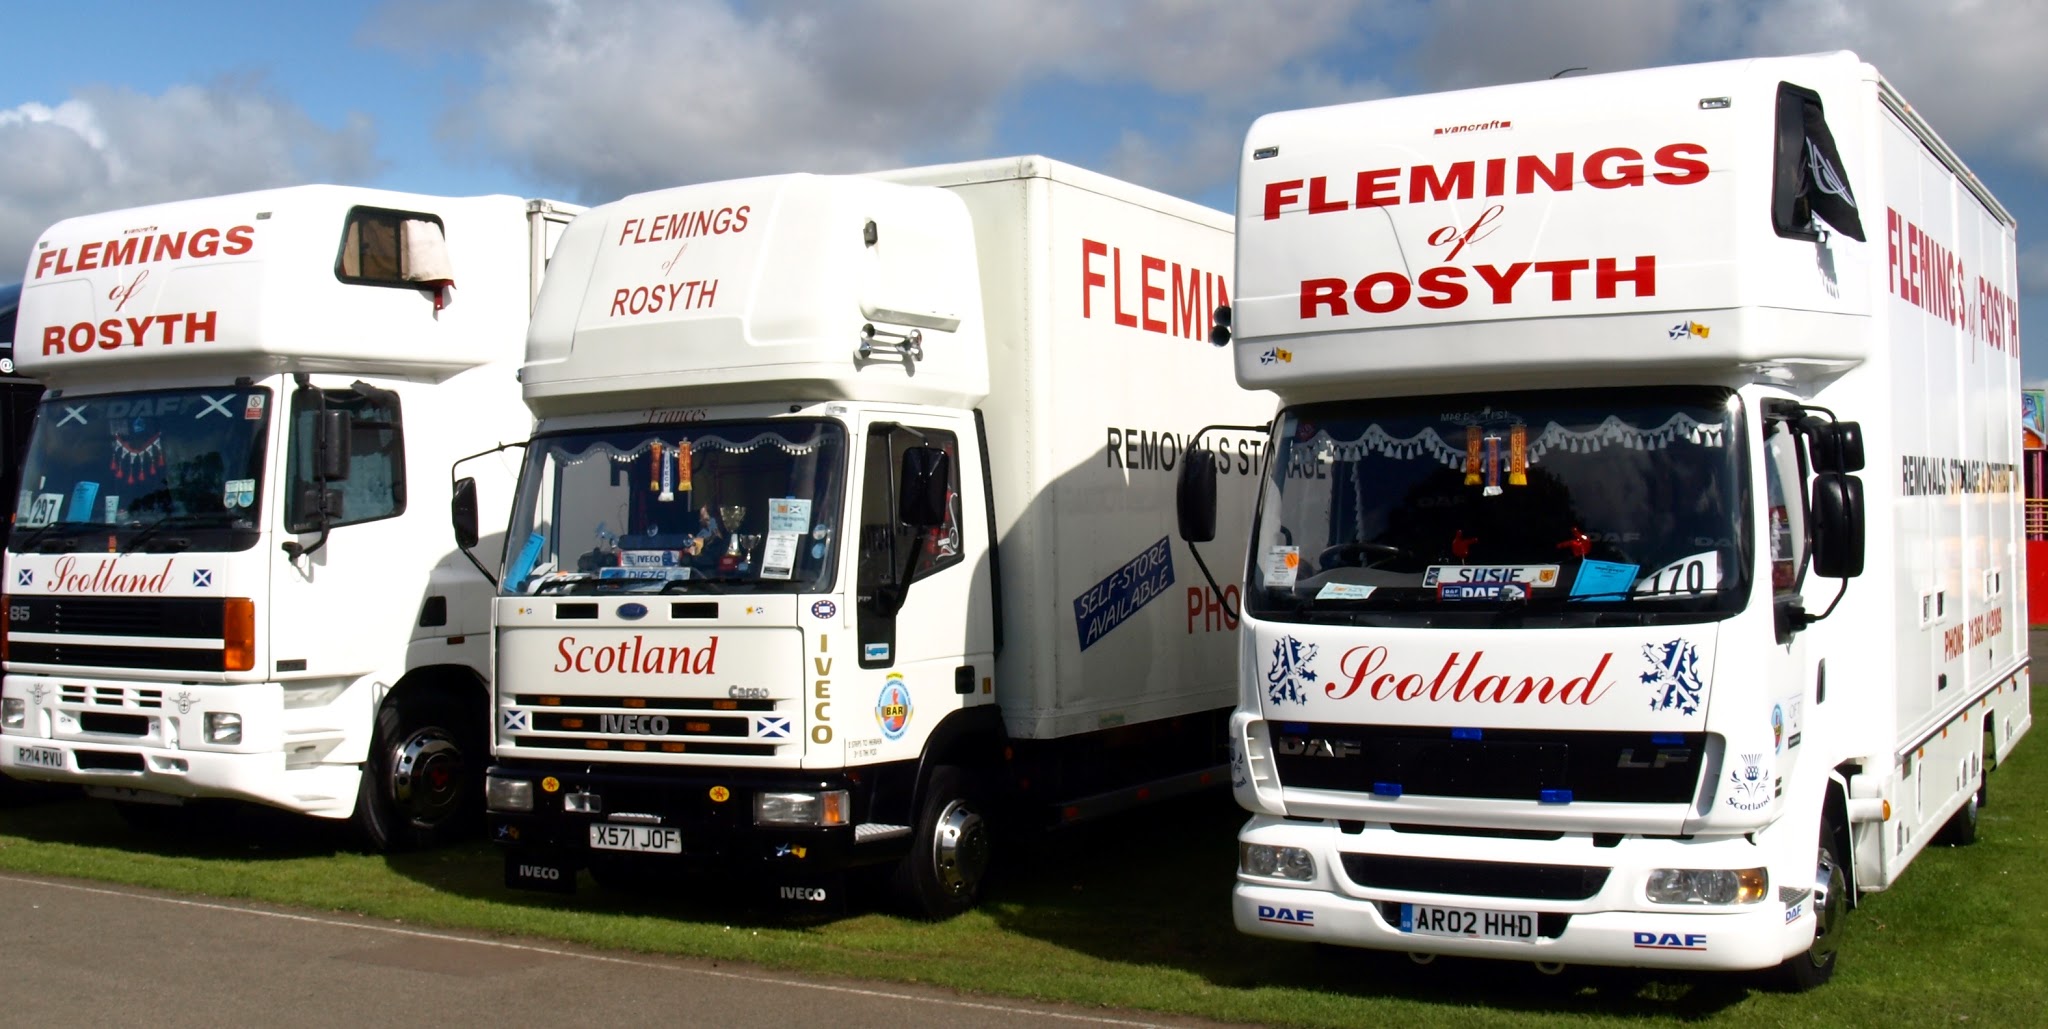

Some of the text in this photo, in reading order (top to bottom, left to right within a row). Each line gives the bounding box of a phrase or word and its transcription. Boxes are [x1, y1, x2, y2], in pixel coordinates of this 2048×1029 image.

[1444, 119, 1499, 134] vancraft
[1264, 143, 1710, 221] FLEMINGS
[619, 205, 750, 246] FLEMINGS
[1427, 205, 1505, 262] of
[35, 225, 255, 279] FLEMINGS
[661, 243, 688, 277] of
[109, 269, 150, 312] of
[1300, 255, 1656, 320] ROSYTH
[1887, 206, 1966, 331] FLEMINGS
[1979, 275, 2018, 359] ROSYTH
[610, 279, 718, 317] ROSYTH
[42, 311, 217, 356] ROSYTH
[106, 397, 177, 418] DAF
[643, 408, 708, 424] Frances
[1107, 427, 1326, 479] REMOVS STOAGE
[1902, 455, 1946, 496] REMOVALS
[1950, 458, 1980, 495] STORAGE
[32, 499, 56, 523] 297
[637, 555, 660, 563] IVECO
[47, 556, 175, 593] Scotland
[1080, 539, 1167, 619] SELF-STORE
[1459, 568, 1524, 582] SUSIE
[1651, 560, 1704, 596] 170
[1462, 587, 1500, 598] DAF
[10, 606, 30, 621] 85
[1086, 565, 1168, 645] AVAILABLE
[554, 635, 718, 675] Scotland
[1325, 645, 1617, 706] Scotland
[728, 685, 769, 699] Cargo
[812, 634, 833, 744] IVECO
[886, 706, 903, 716] BAR
[600, 714, 669, 735] IVECO
[20, 748, 62, 767] R214 RVU
[1279, 736, 1360, 758] DAF
[1617, 748, 1691, 768] LF
[1726, 795, 1771, 811] Scotland
[597, 826, 676, 849] X571 JOF
[520, 864, 559, 880] IVECO
[780, 886, 826, 901] IVECO
[1258, 905, 1314, 919] DAF
[1417, 908, 1532, 938] AR02 HHD
[1786, 904, 1801, 921] DAF
[1634, 932, 1707, 946] DAF
